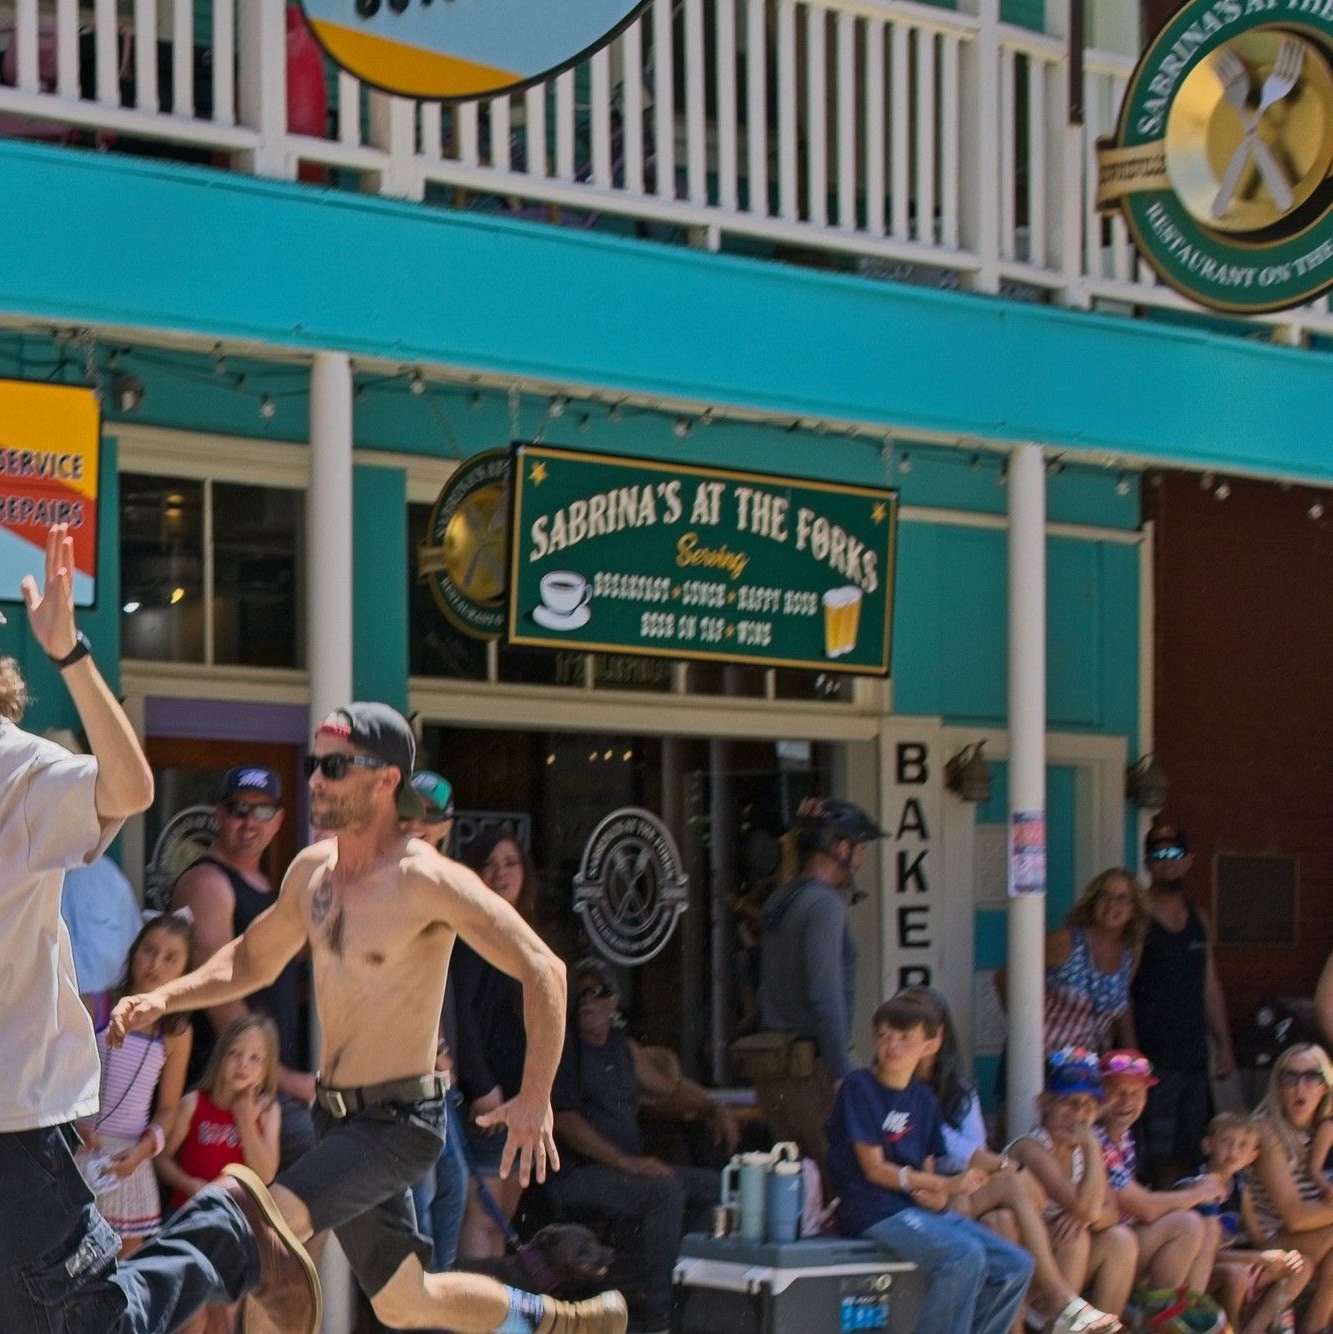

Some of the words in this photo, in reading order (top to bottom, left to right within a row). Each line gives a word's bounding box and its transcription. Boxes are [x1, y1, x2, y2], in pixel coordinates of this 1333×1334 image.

[530, 479, 683, 563] SABRINA'S
[690, 481, 726, 525] AT
[734, 486, 789, 543] THE
[795, 506, 879, 594] FORKS
